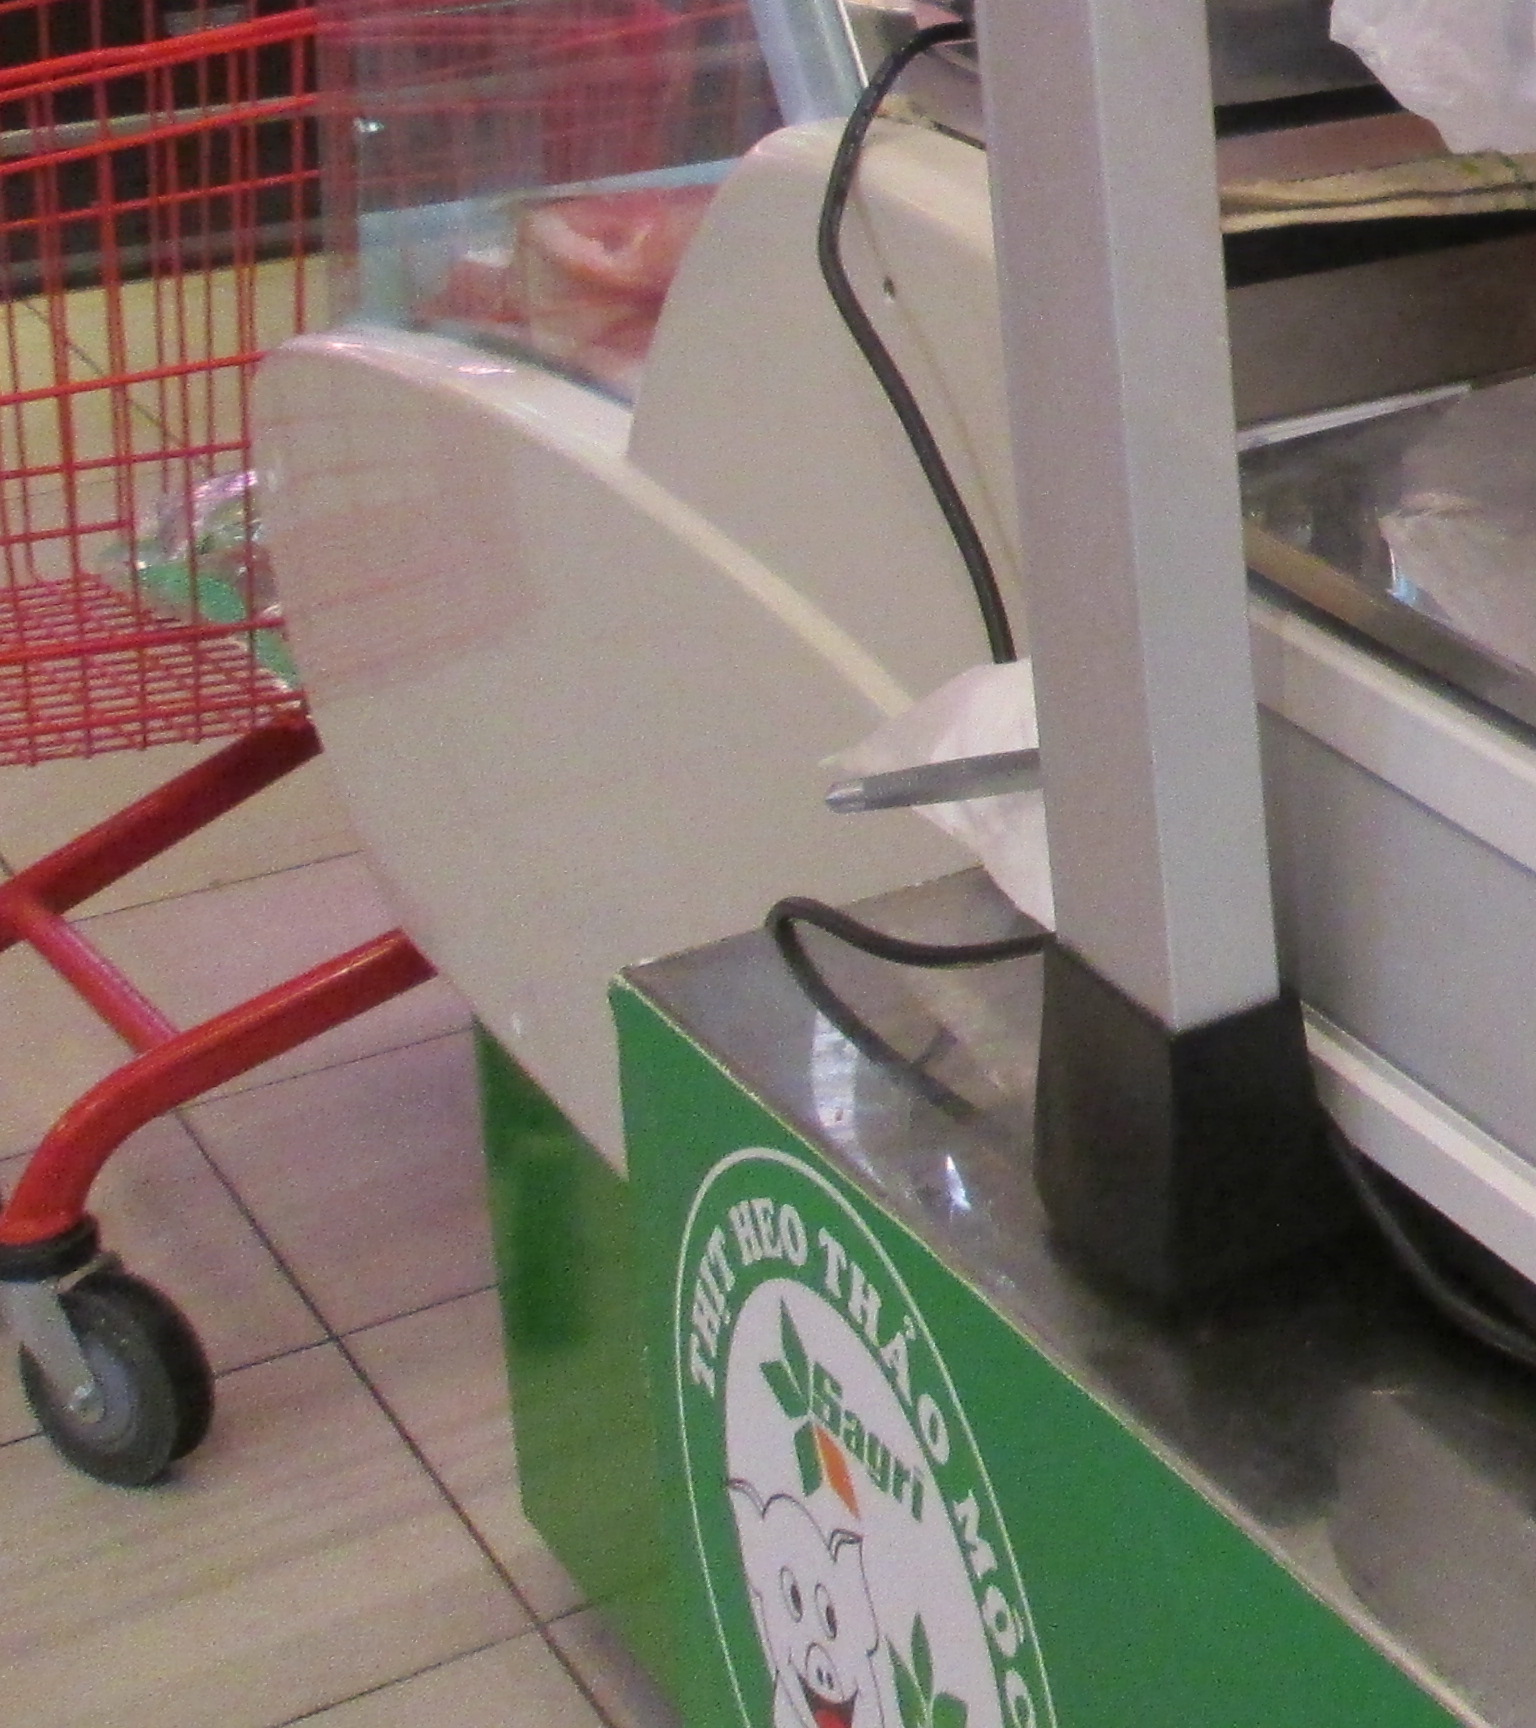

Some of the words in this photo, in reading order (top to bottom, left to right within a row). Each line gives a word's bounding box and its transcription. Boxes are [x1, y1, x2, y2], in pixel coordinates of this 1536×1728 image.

[691, 1227, 736, 1397] THỊT
[729, 1197, 808, 1266] HEO
[818, 1227, 950, 1466] THẢO
